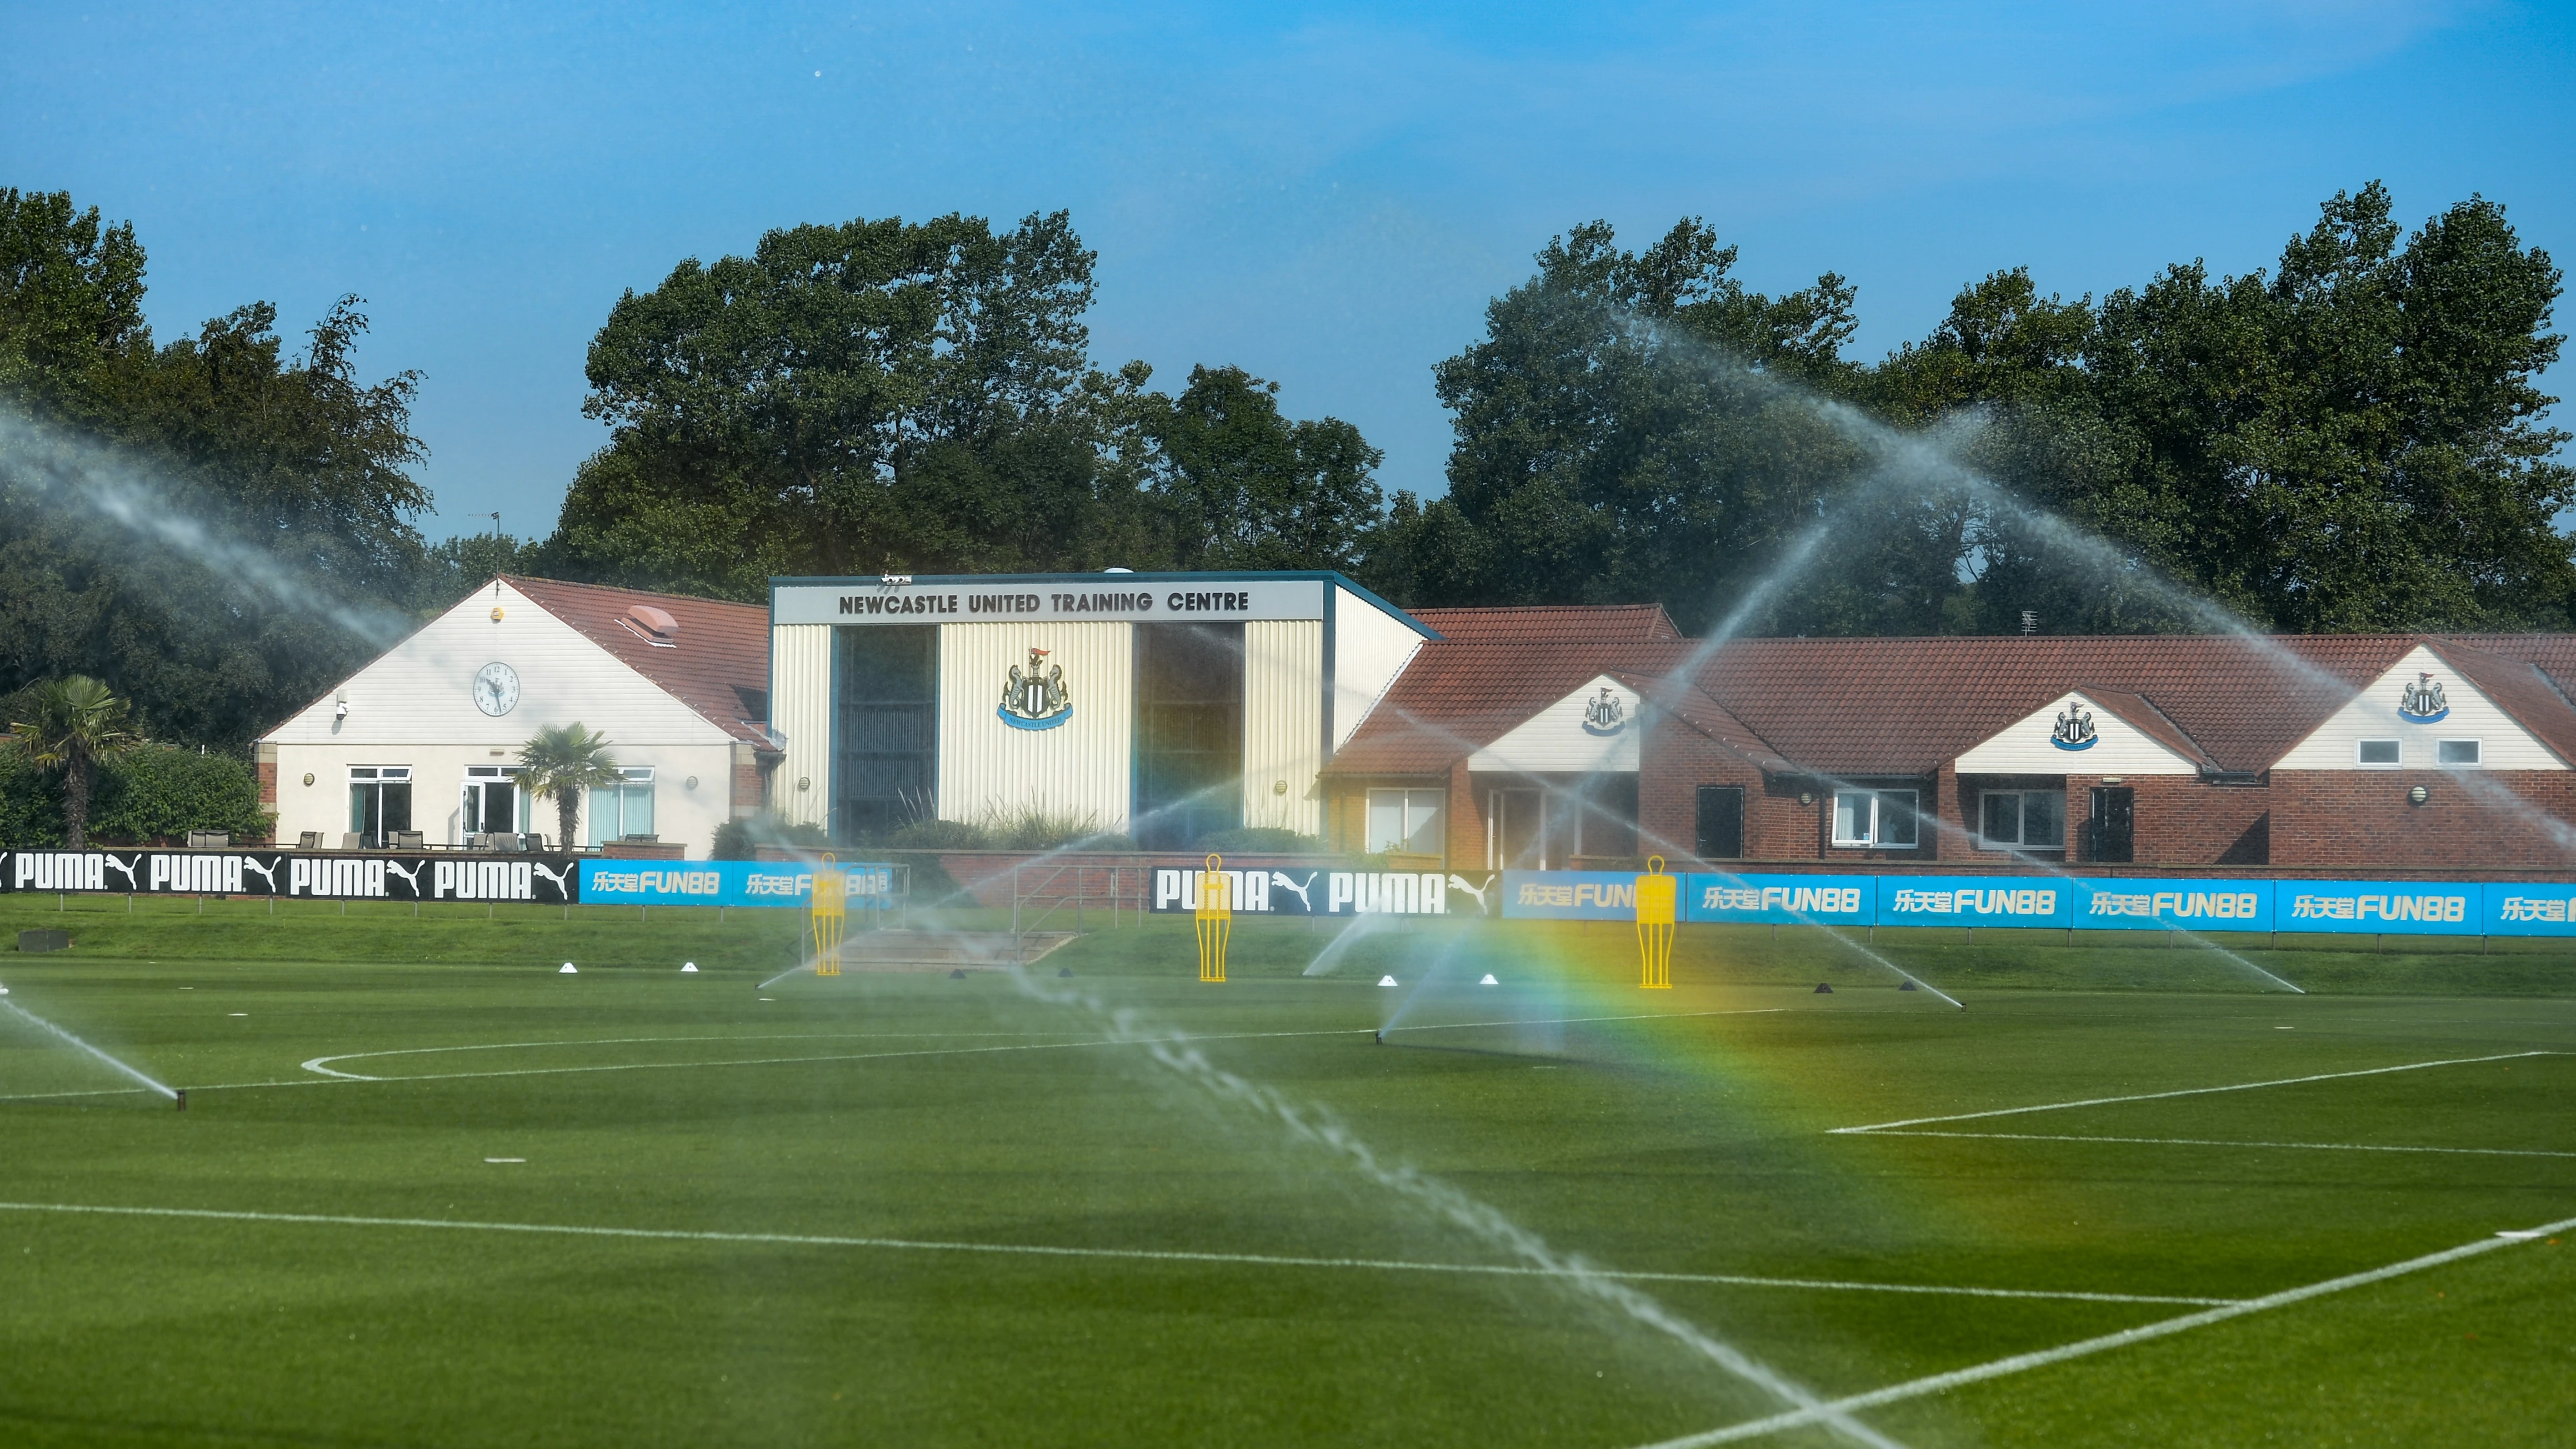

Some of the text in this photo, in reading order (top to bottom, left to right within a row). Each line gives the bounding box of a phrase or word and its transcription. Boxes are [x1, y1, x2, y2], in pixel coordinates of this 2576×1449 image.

[839, 592, 1248, 614] NEWCASTLE UNITED TRAINING CENTRE
[1009, 717, 1062, 728] NEWCASTLE UNITED
[16, 854, 103, 889] PUMA
[151, 855, 242, 891] PUMA
[291, 859, 384, 896] PUMA
[435, 861, 531, 899] PUMA
[1329, 873, 1445, 914] PUMA
